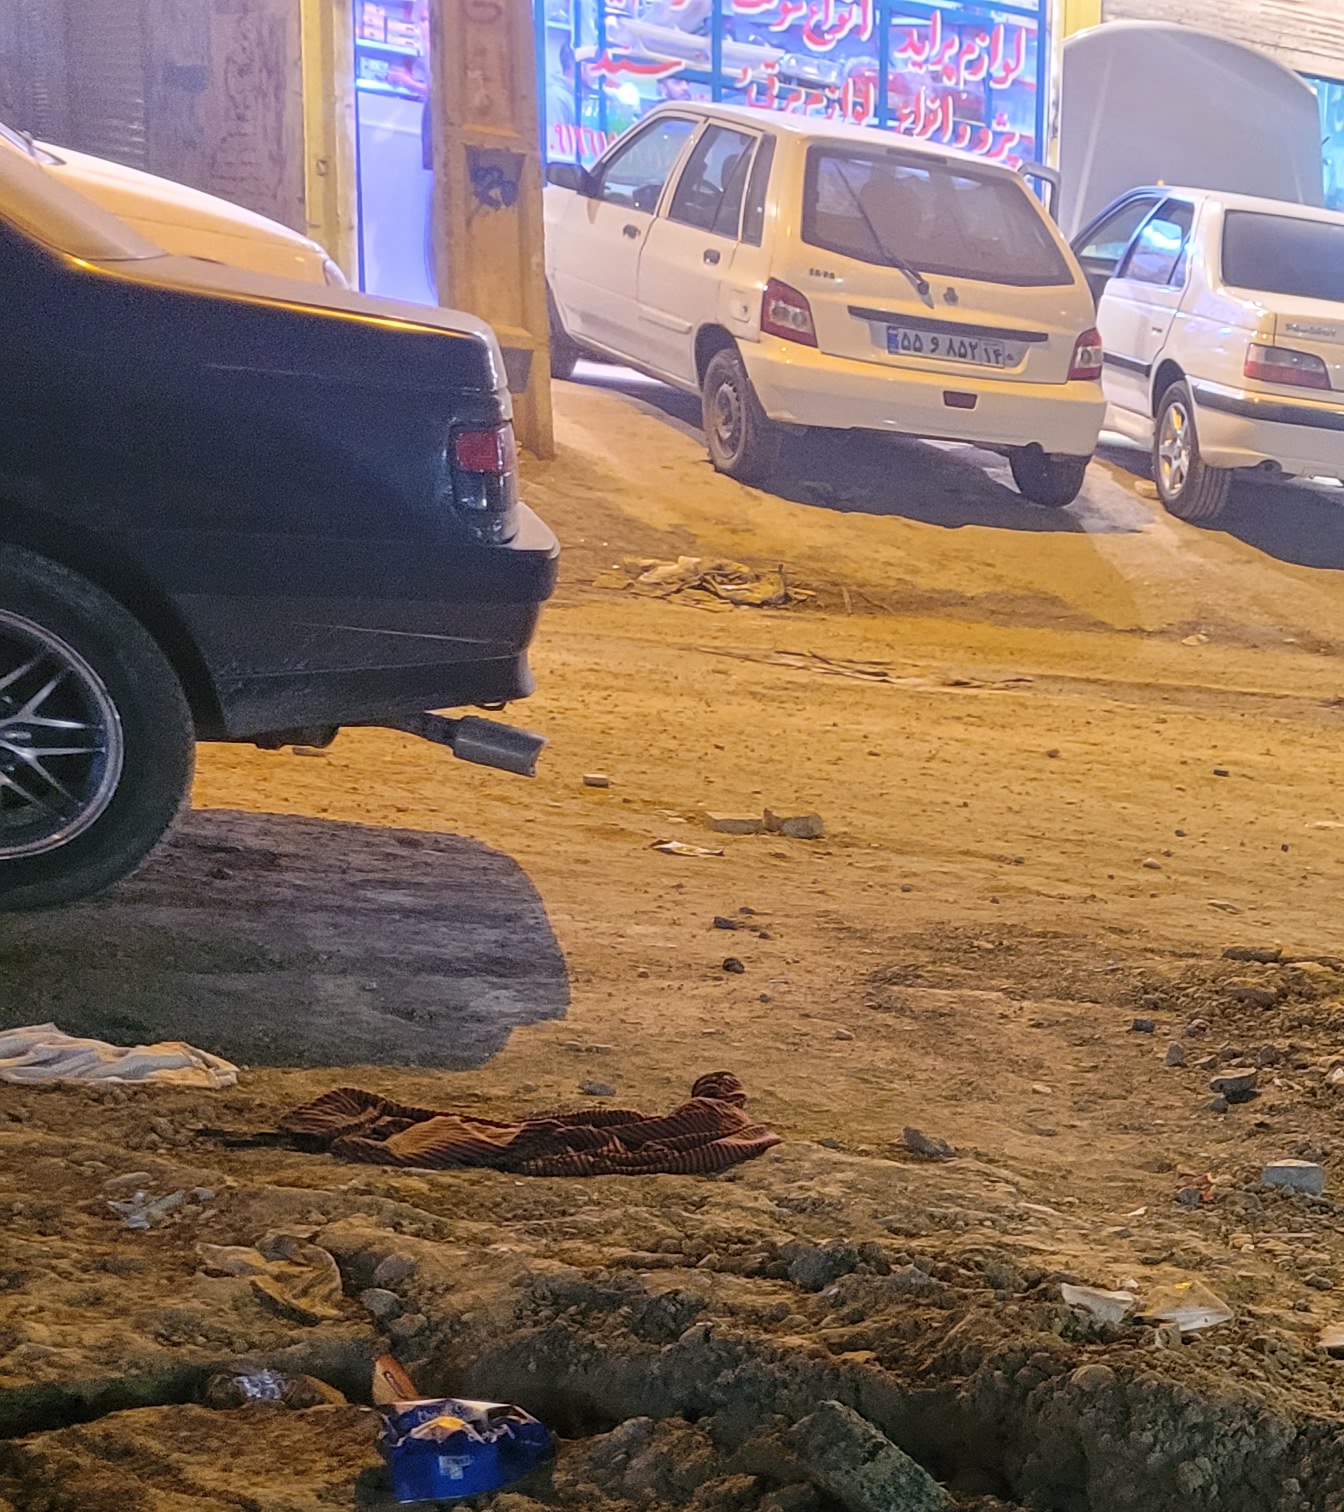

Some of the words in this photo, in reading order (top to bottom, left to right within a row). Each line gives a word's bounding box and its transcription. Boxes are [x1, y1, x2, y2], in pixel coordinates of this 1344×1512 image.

[893, 9, 960, 85] پراید
[958, 23, 1026, 91] لوازم
[901, 331, 922, 352] ۵۵
[931, 336, 939, 353] و
[984, 347, 1002, 364] ۱۴
